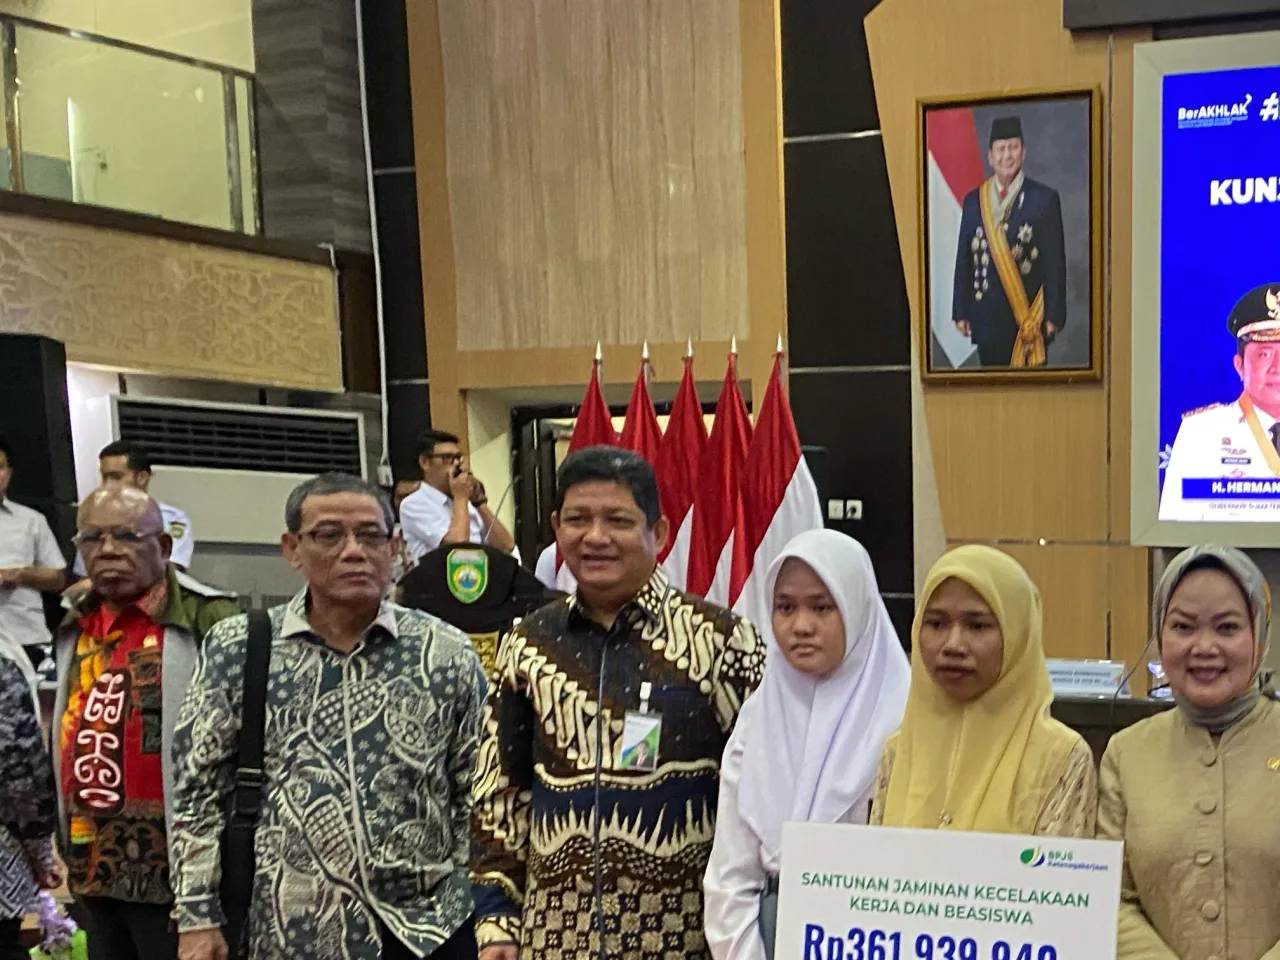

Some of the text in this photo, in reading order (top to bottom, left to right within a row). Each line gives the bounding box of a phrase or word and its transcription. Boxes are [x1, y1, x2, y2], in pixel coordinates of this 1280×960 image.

[1177, 94, 1252, 120] BerAKHLAK
[1211, 481, 1226, 494] H.
[1048, 850, 1074, 861] BPJS
[801, 871, 1090, 908] SANTUNAN JAMINAN KECELAKAAN
[849, 896, 1034, 925] KERJA DAN BEASISWA
